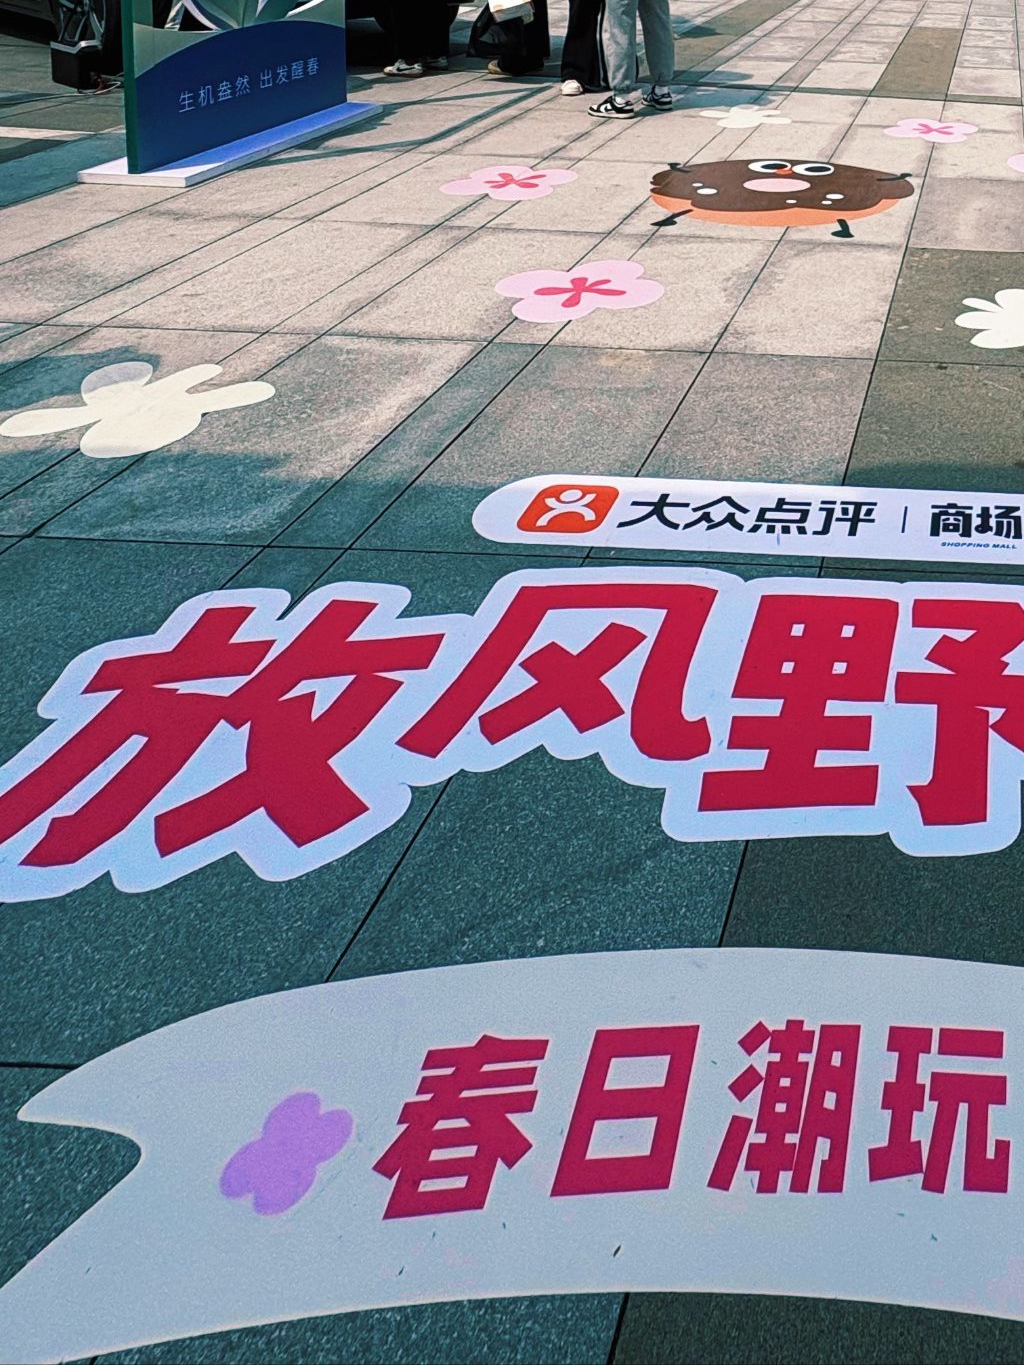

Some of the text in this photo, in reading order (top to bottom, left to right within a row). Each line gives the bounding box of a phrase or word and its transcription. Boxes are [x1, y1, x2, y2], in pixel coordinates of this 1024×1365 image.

[178, 57, 320, 113] 生机盎然 出发醒春
[617, 493, 878, 536] 大众点评
[941, 541, 990, 549] SHOPPING
[374, 1021, 1011, 1219] 春日潮玩
